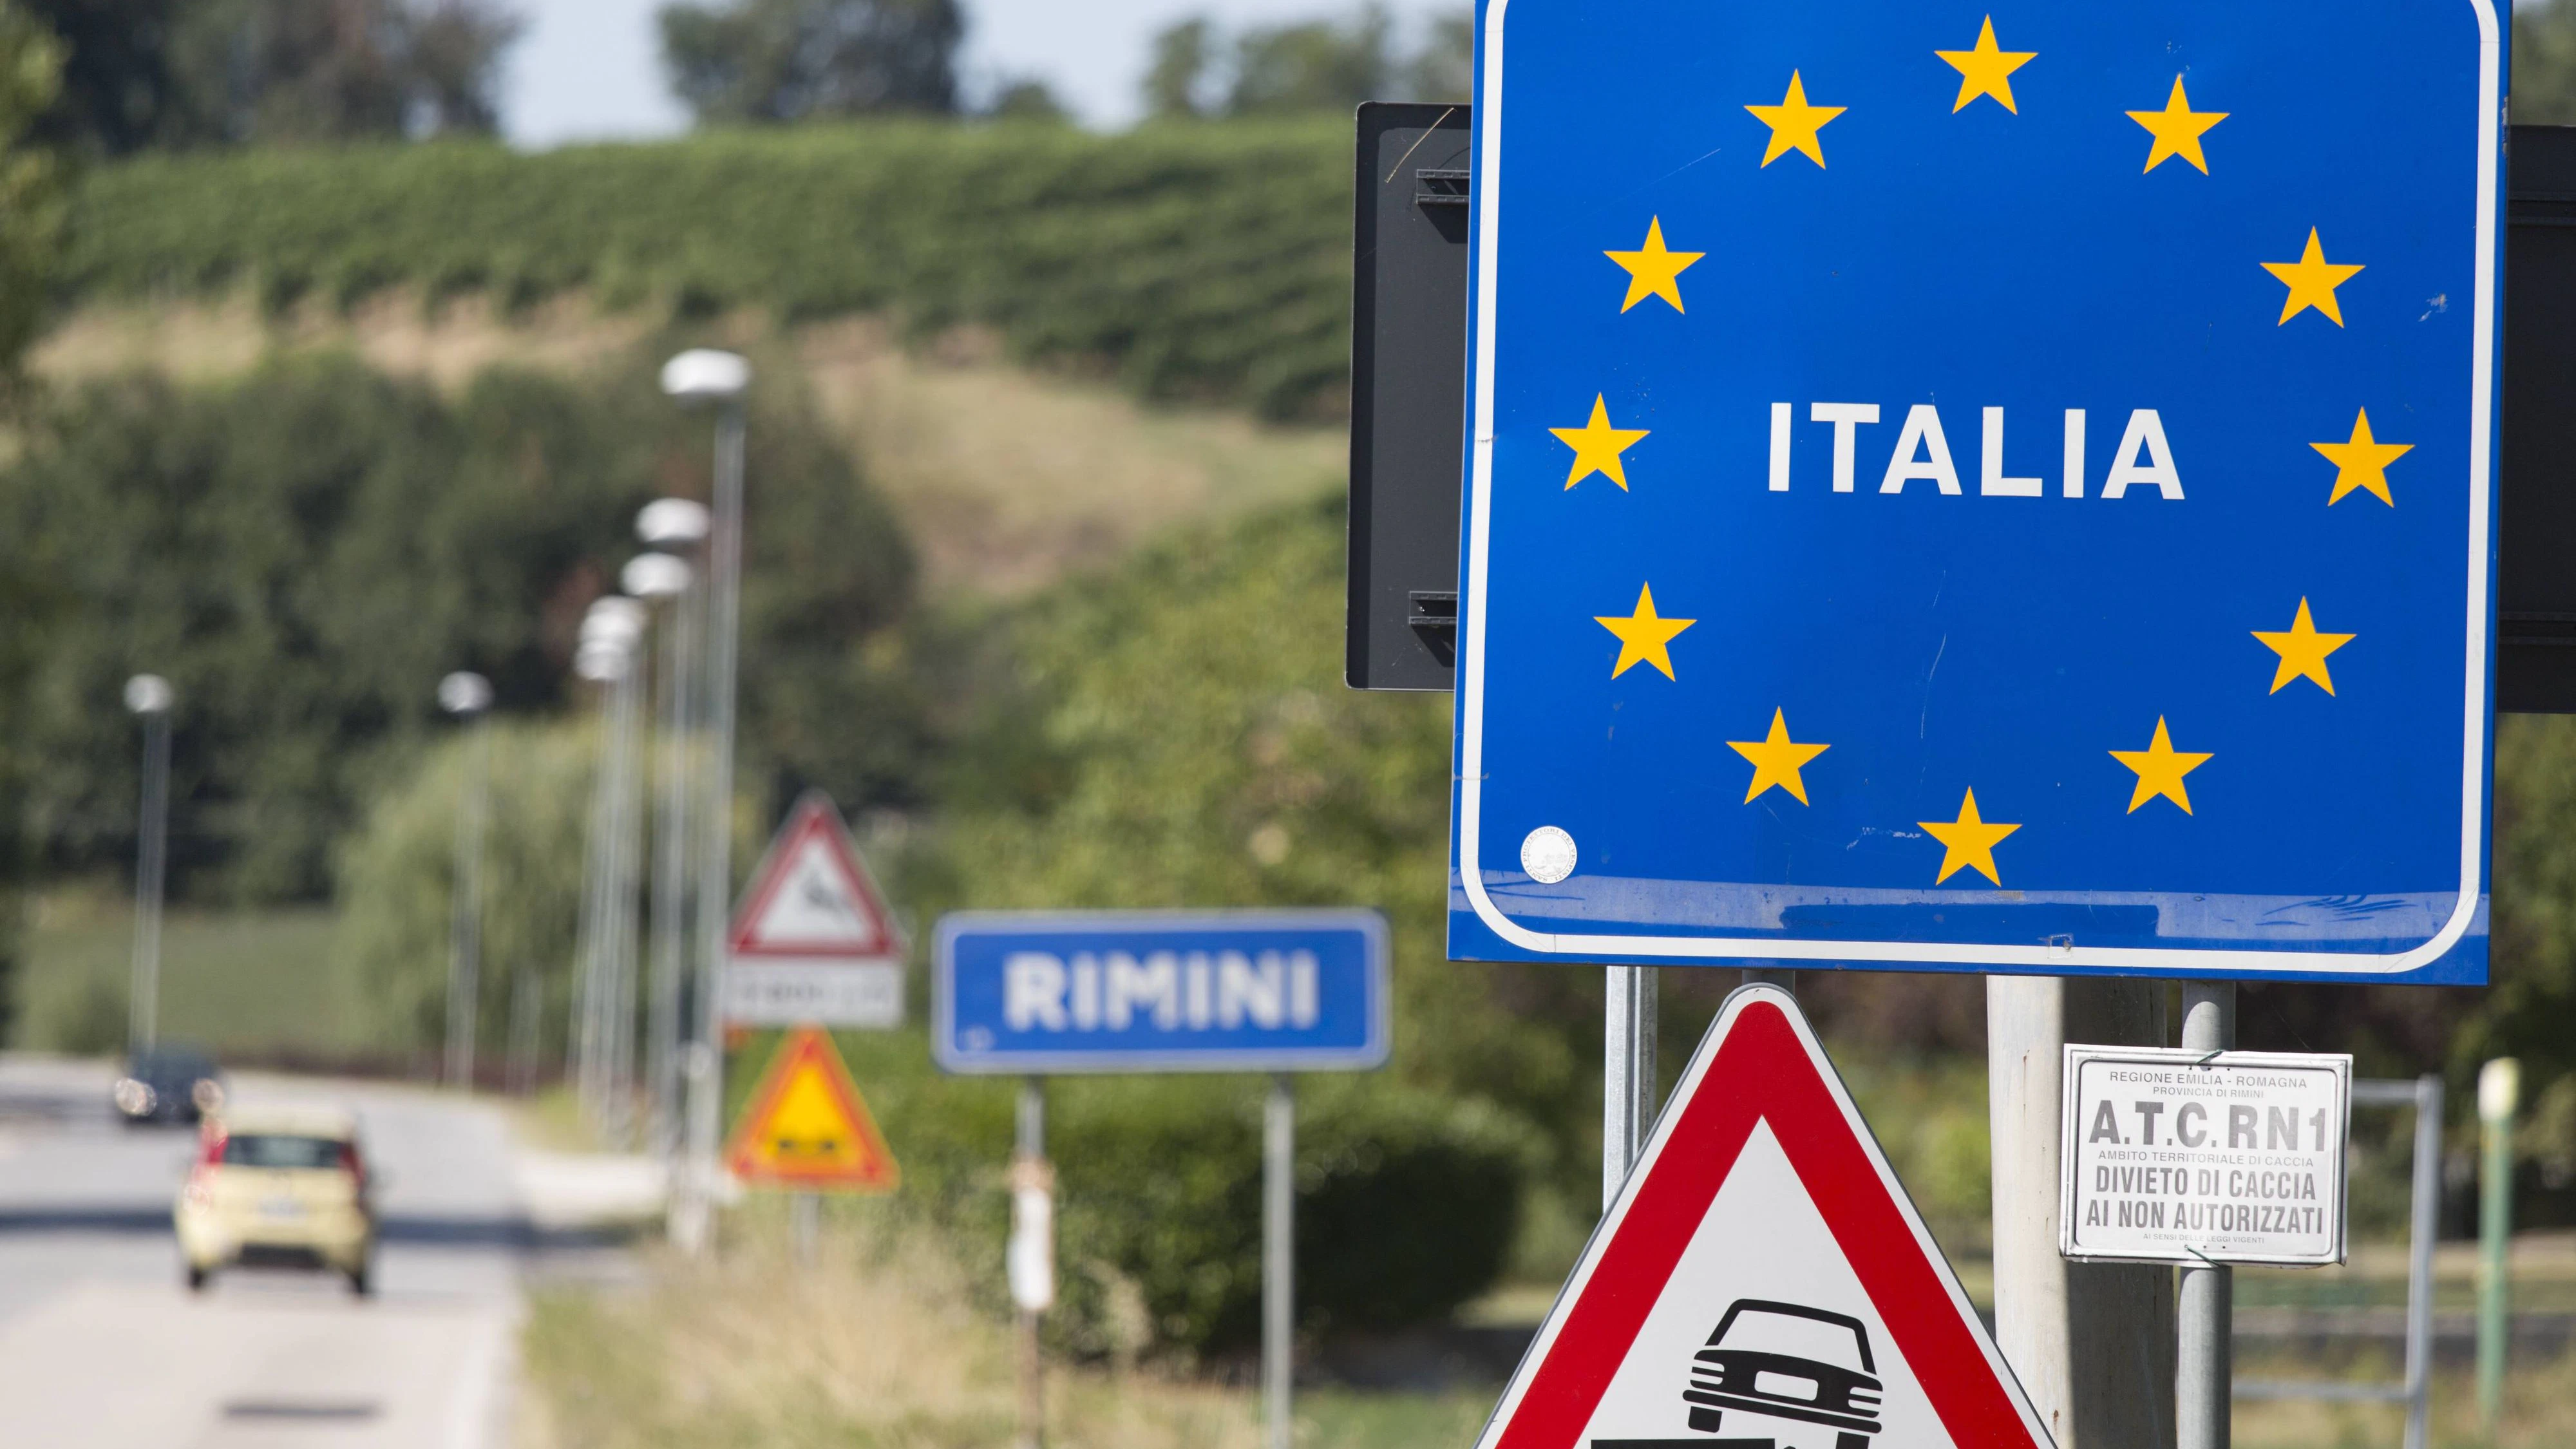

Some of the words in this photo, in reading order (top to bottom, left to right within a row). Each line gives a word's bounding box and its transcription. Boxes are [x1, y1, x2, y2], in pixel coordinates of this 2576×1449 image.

[1768, 402, 2185, 500] ITALIA
[1004, 951, 1320, 1031] RIMINI
[2110, 1072, 2172, 1083] REGIONE
[2177, 1074, 2222, 1085] EMILIA
[2237, 1076, 2307, 1088] ROMAGNA
[2154, 1086, 2212, 1096] PROVINCIA
[2230, 1090, 2263, 1098] RIMINI
[2099, 1150, 2146, 1160] AMBITO
[2152, 1151, 2244, 1164] TERRITORIALE
[2249, 1156, 2260, 1164] DI
[2265, 1157, 2313, 1168] CACCIA
[2096, 1166, 2188, 1195] DIVIETO
[2198, 1170, 2219, 1196] DI
[2230, 1170, 2316, 1200] CACCIA
[2087, 1200, 2108, 1226] AI
[2119, 1200, 2164, 1228] NON
[2174, 1202, 2322, 1234] AUTORIZZATI
